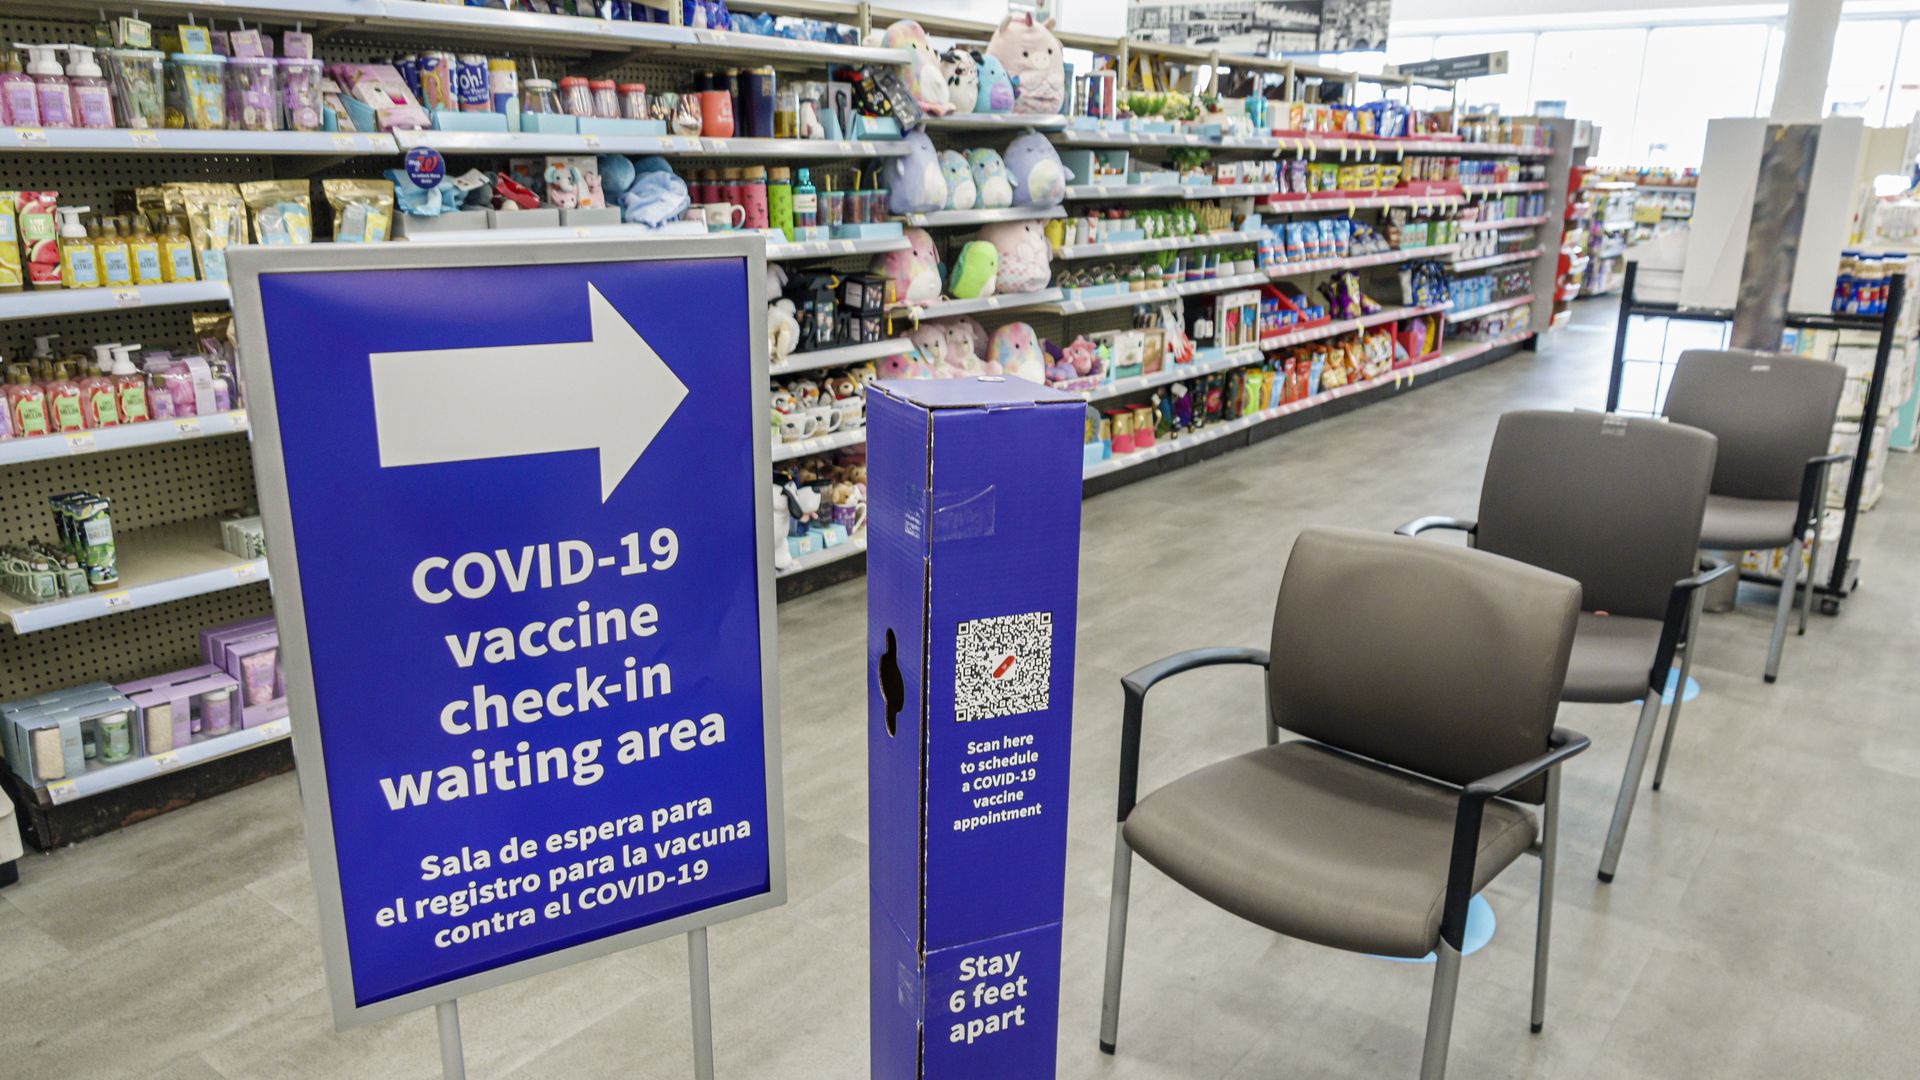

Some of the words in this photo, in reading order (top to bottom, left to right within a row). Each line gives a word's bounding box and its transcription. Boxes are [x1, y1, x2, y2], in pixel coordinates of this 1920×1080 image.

[412, 528, 679, 604] COVID-19
[445, 601, 659, 668] vaccine
[440, 657, 672, 736] check-in
[380, 739, 605, 811] waiting
[616, 713, 726, 765] area
[960, 761, 975, 774] to
[978, 749, 1039, 772] schedule
[967, 740, 1001, 755] Scan
[1003, 734, 1034, 749] here
[962, 782, 971, 793] a
[973, 768, 1036, 791] COVID-19
[973, 790, 1024, 809] vaccine
[953, 803, 1042, 832] appointment
[420, 847, 491, 881] Sala
[500, 836, 538, 863] de
[545, 815, 644, 853] espera
[651, 798, 713, 833] para
[376, 898, 407, 928] el
[415, 873, 541, 919] registro
[549, 855, 615, 892] para
[622, 845, 648, 868] la
[654, 820, 751, 860] vacuna
[434, 908, 536, 948] contra
[543, 893, 571, 920] el
[578, 859, 709, 910] COVID-19
[958, 950, 1022, 982] Stay
[949, 989, 966, 1014] 6
[973, 975, 1028, 1009] feet
[949, 1004, 1026, 1045] apart
